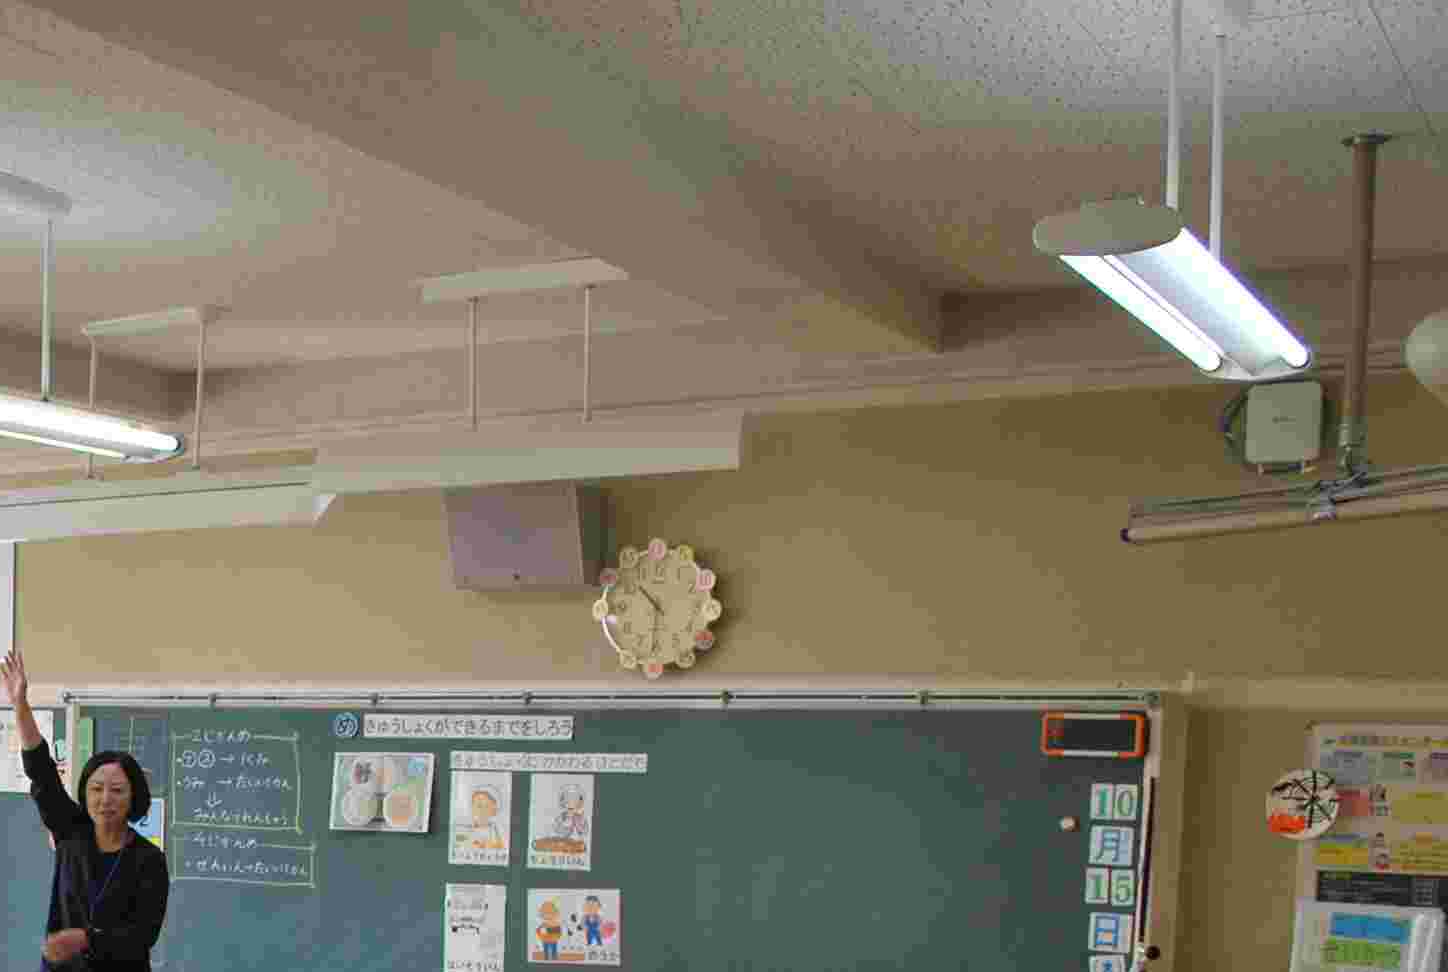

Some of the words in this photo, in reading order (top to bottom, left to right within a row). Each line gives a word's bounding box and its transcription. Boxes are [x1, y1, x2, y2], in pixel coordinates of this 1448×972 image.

[364, 717, 572, 737] きゅうしょくができるまでをしろう
[1098, 787, 1133, 817] 10
[1096, 831, 1119, 863] 月
[1092, 873, 1131, 903] 15
[1095, 914, 1119, 947] 日
